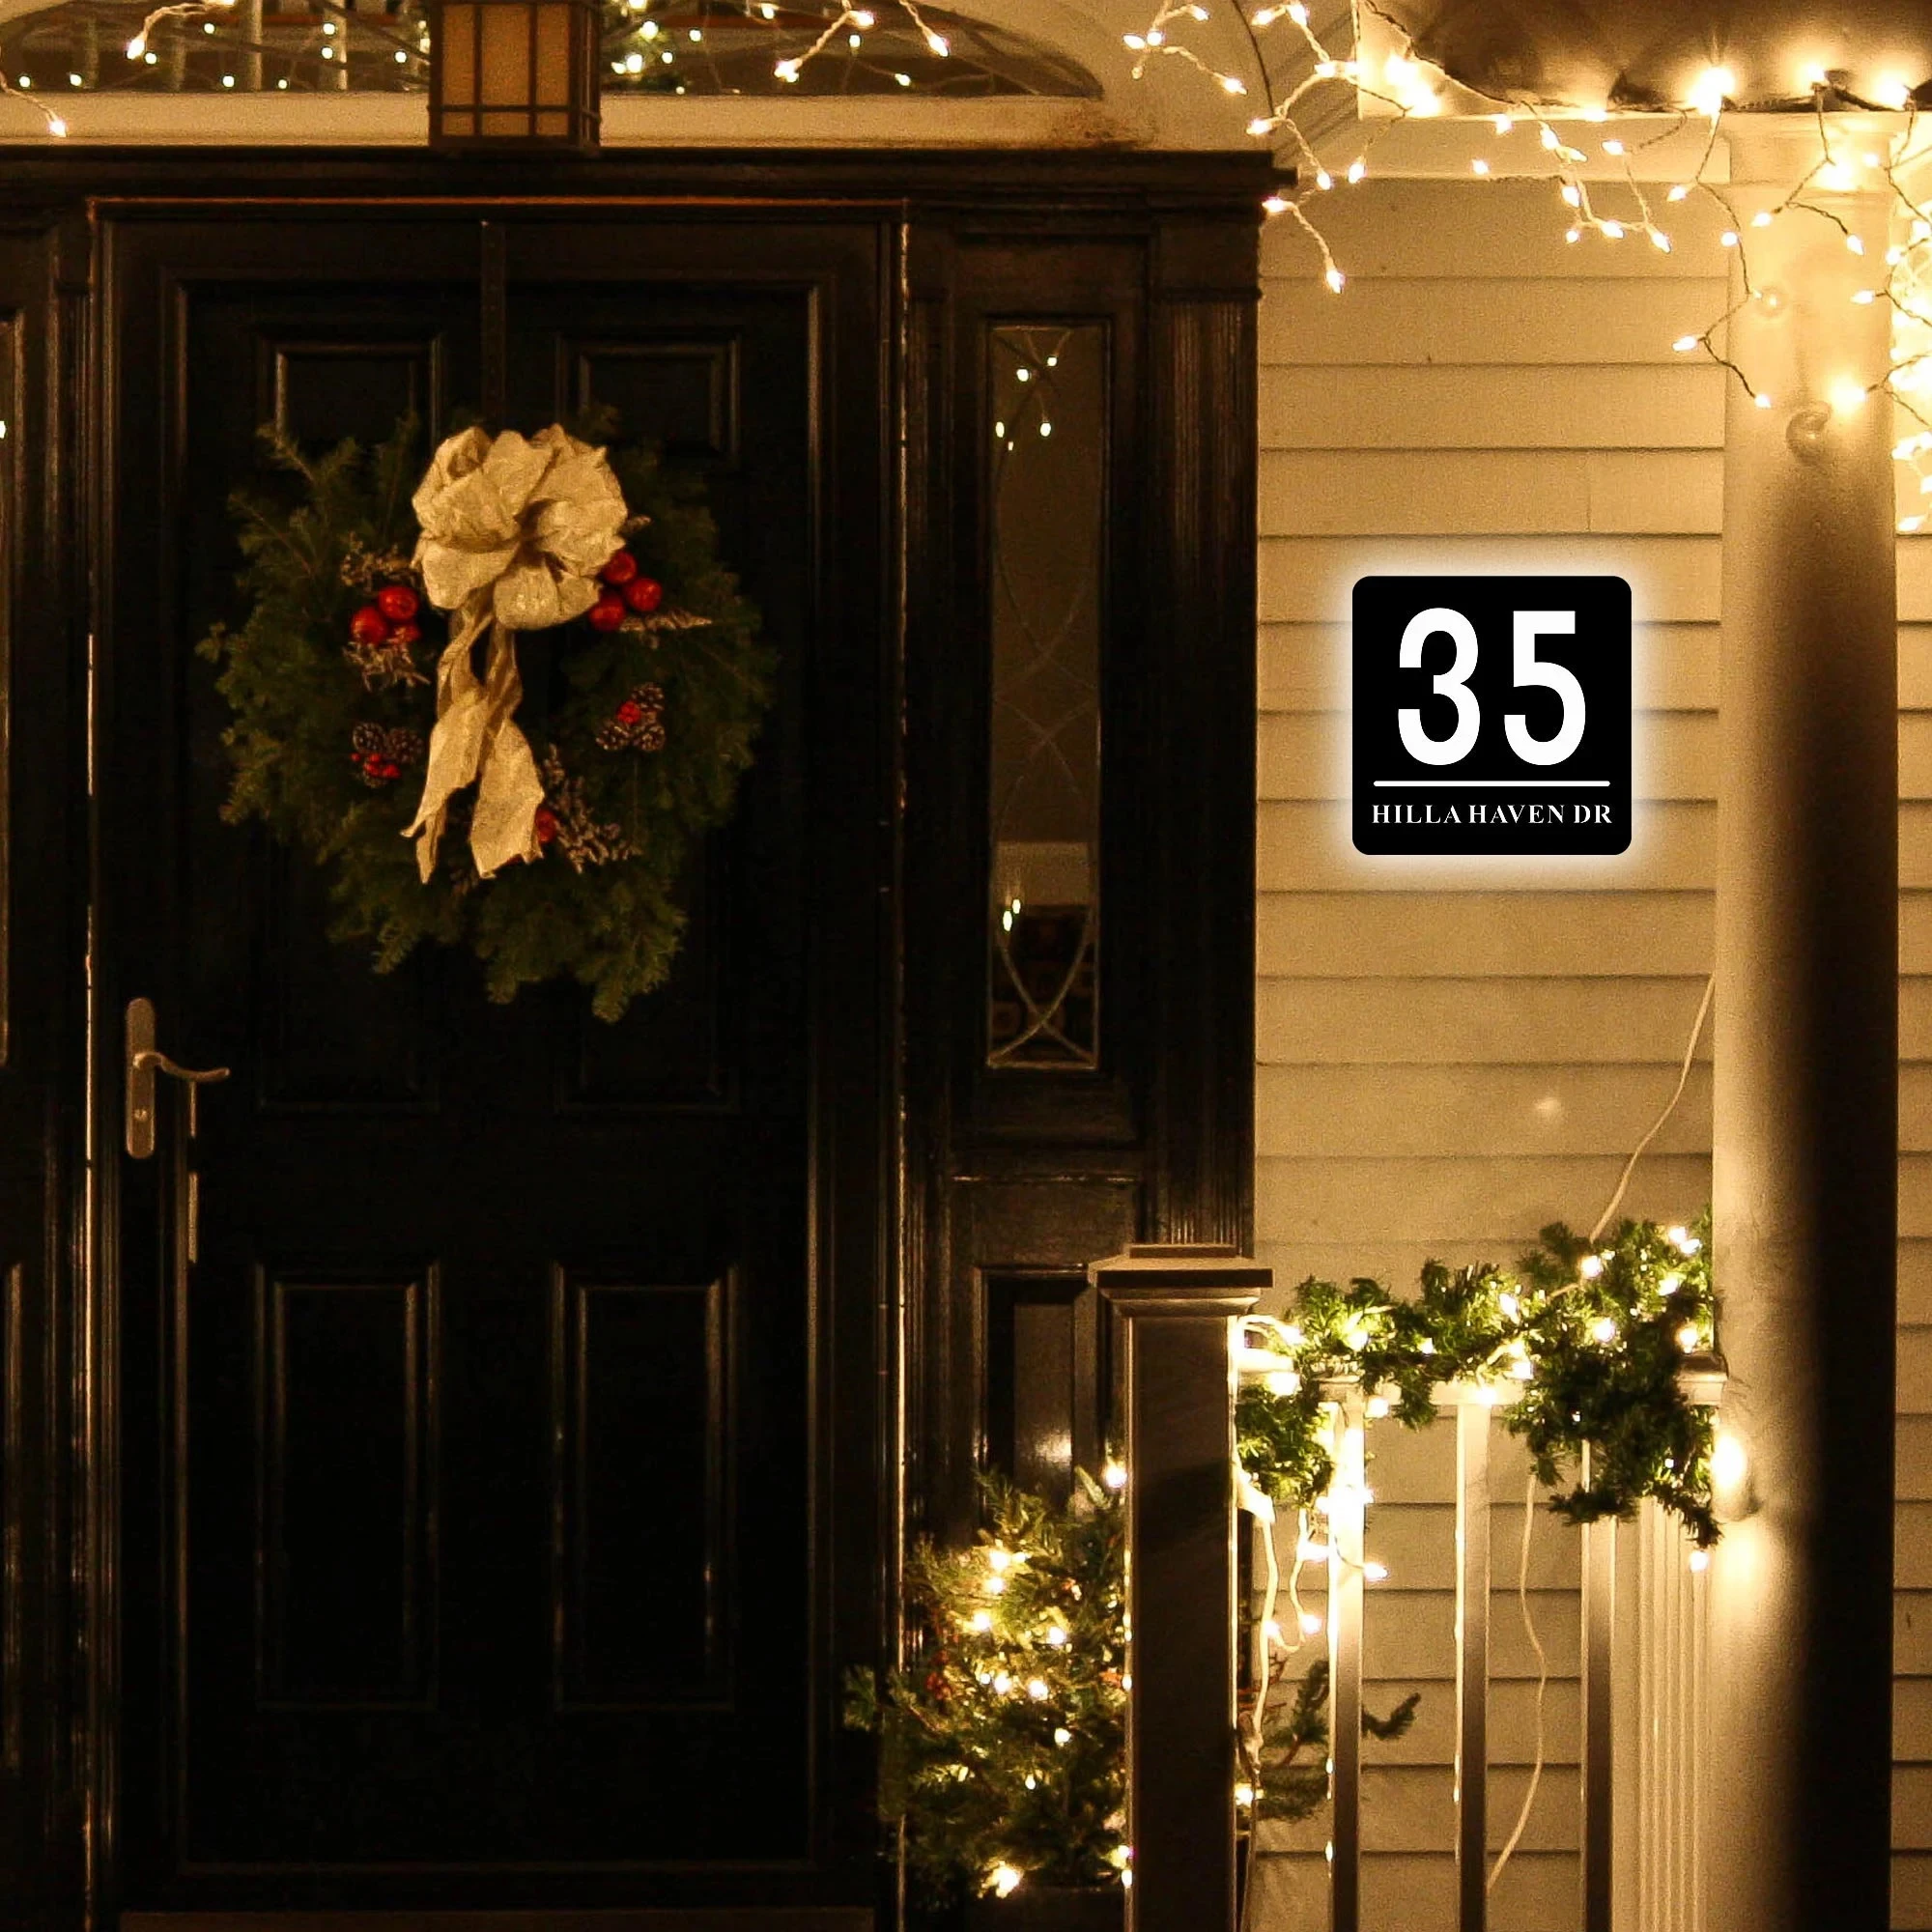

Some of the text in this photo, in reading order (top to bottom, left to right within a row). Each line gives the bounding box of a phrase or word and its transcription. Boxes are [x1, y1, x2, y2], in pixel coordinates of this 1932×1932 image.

[1397, 607, 1586, 766] 35
[1372, 805, 1612, 824] HILLA HAVEN DR
